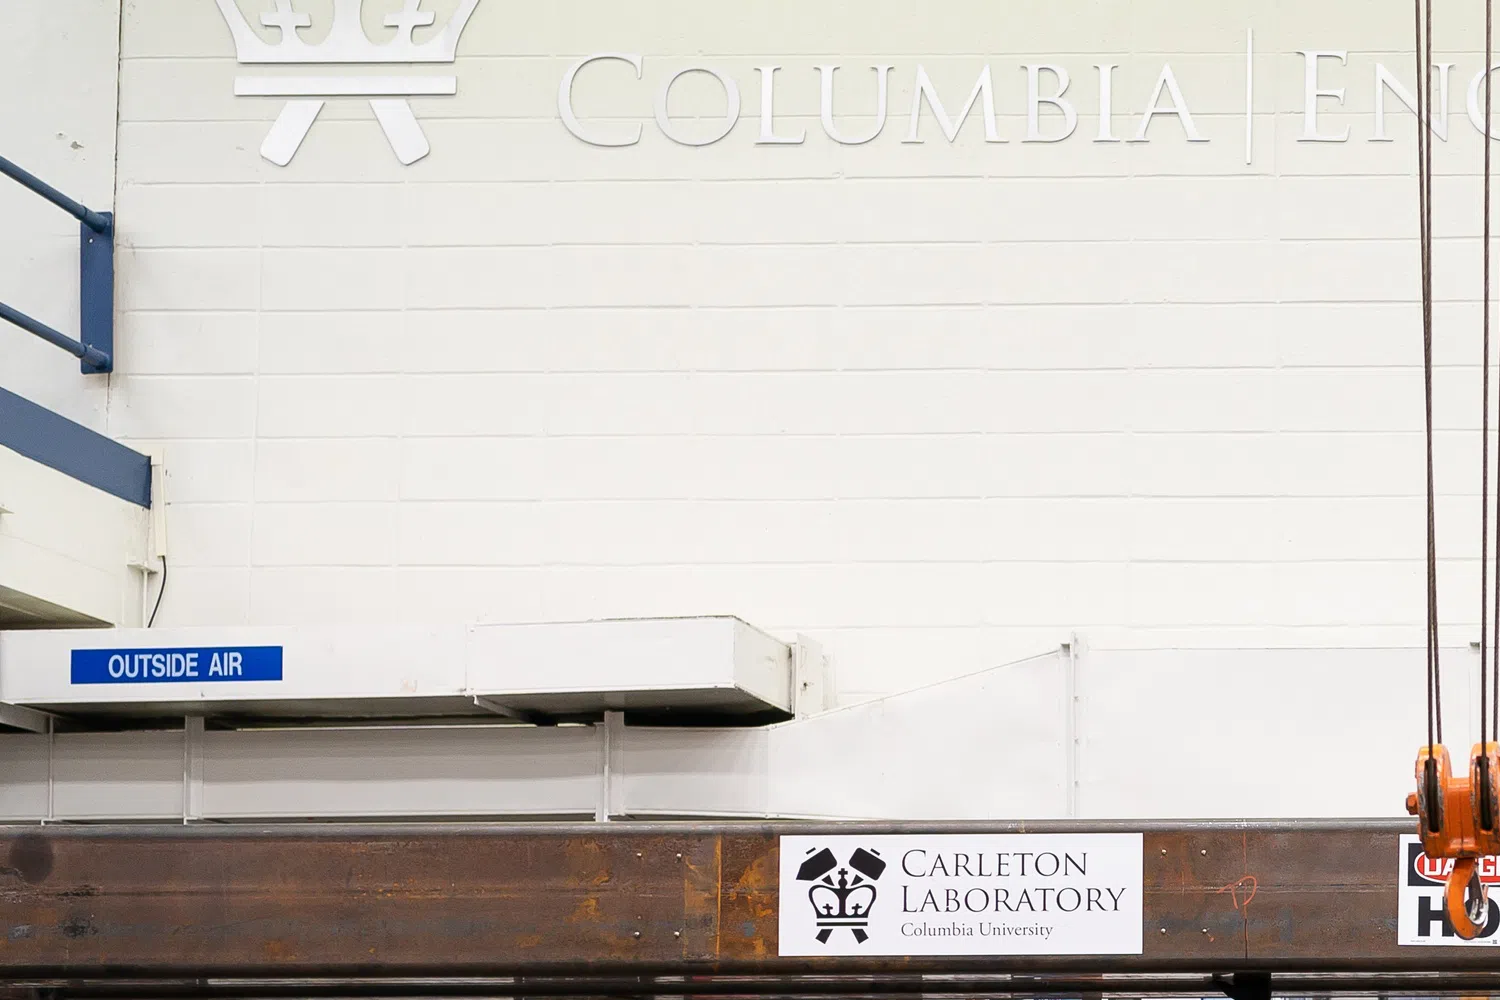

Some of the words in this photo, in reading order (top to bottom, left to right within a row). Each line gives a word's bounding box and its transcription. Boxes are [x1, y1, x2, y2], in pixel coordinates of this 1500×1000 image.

[557, 52, 1211, 148] COLUMBIA
[108, 653, 199, 678] OUTSIDE
[208, 652, 243, 676] AIR
[901, 849, 1088, 877] CARLETON
[901, 885, 1127, 913] LABORATORY
[901, 922, 974, 937] Columbia
[979, 922, 1054, 940] University
